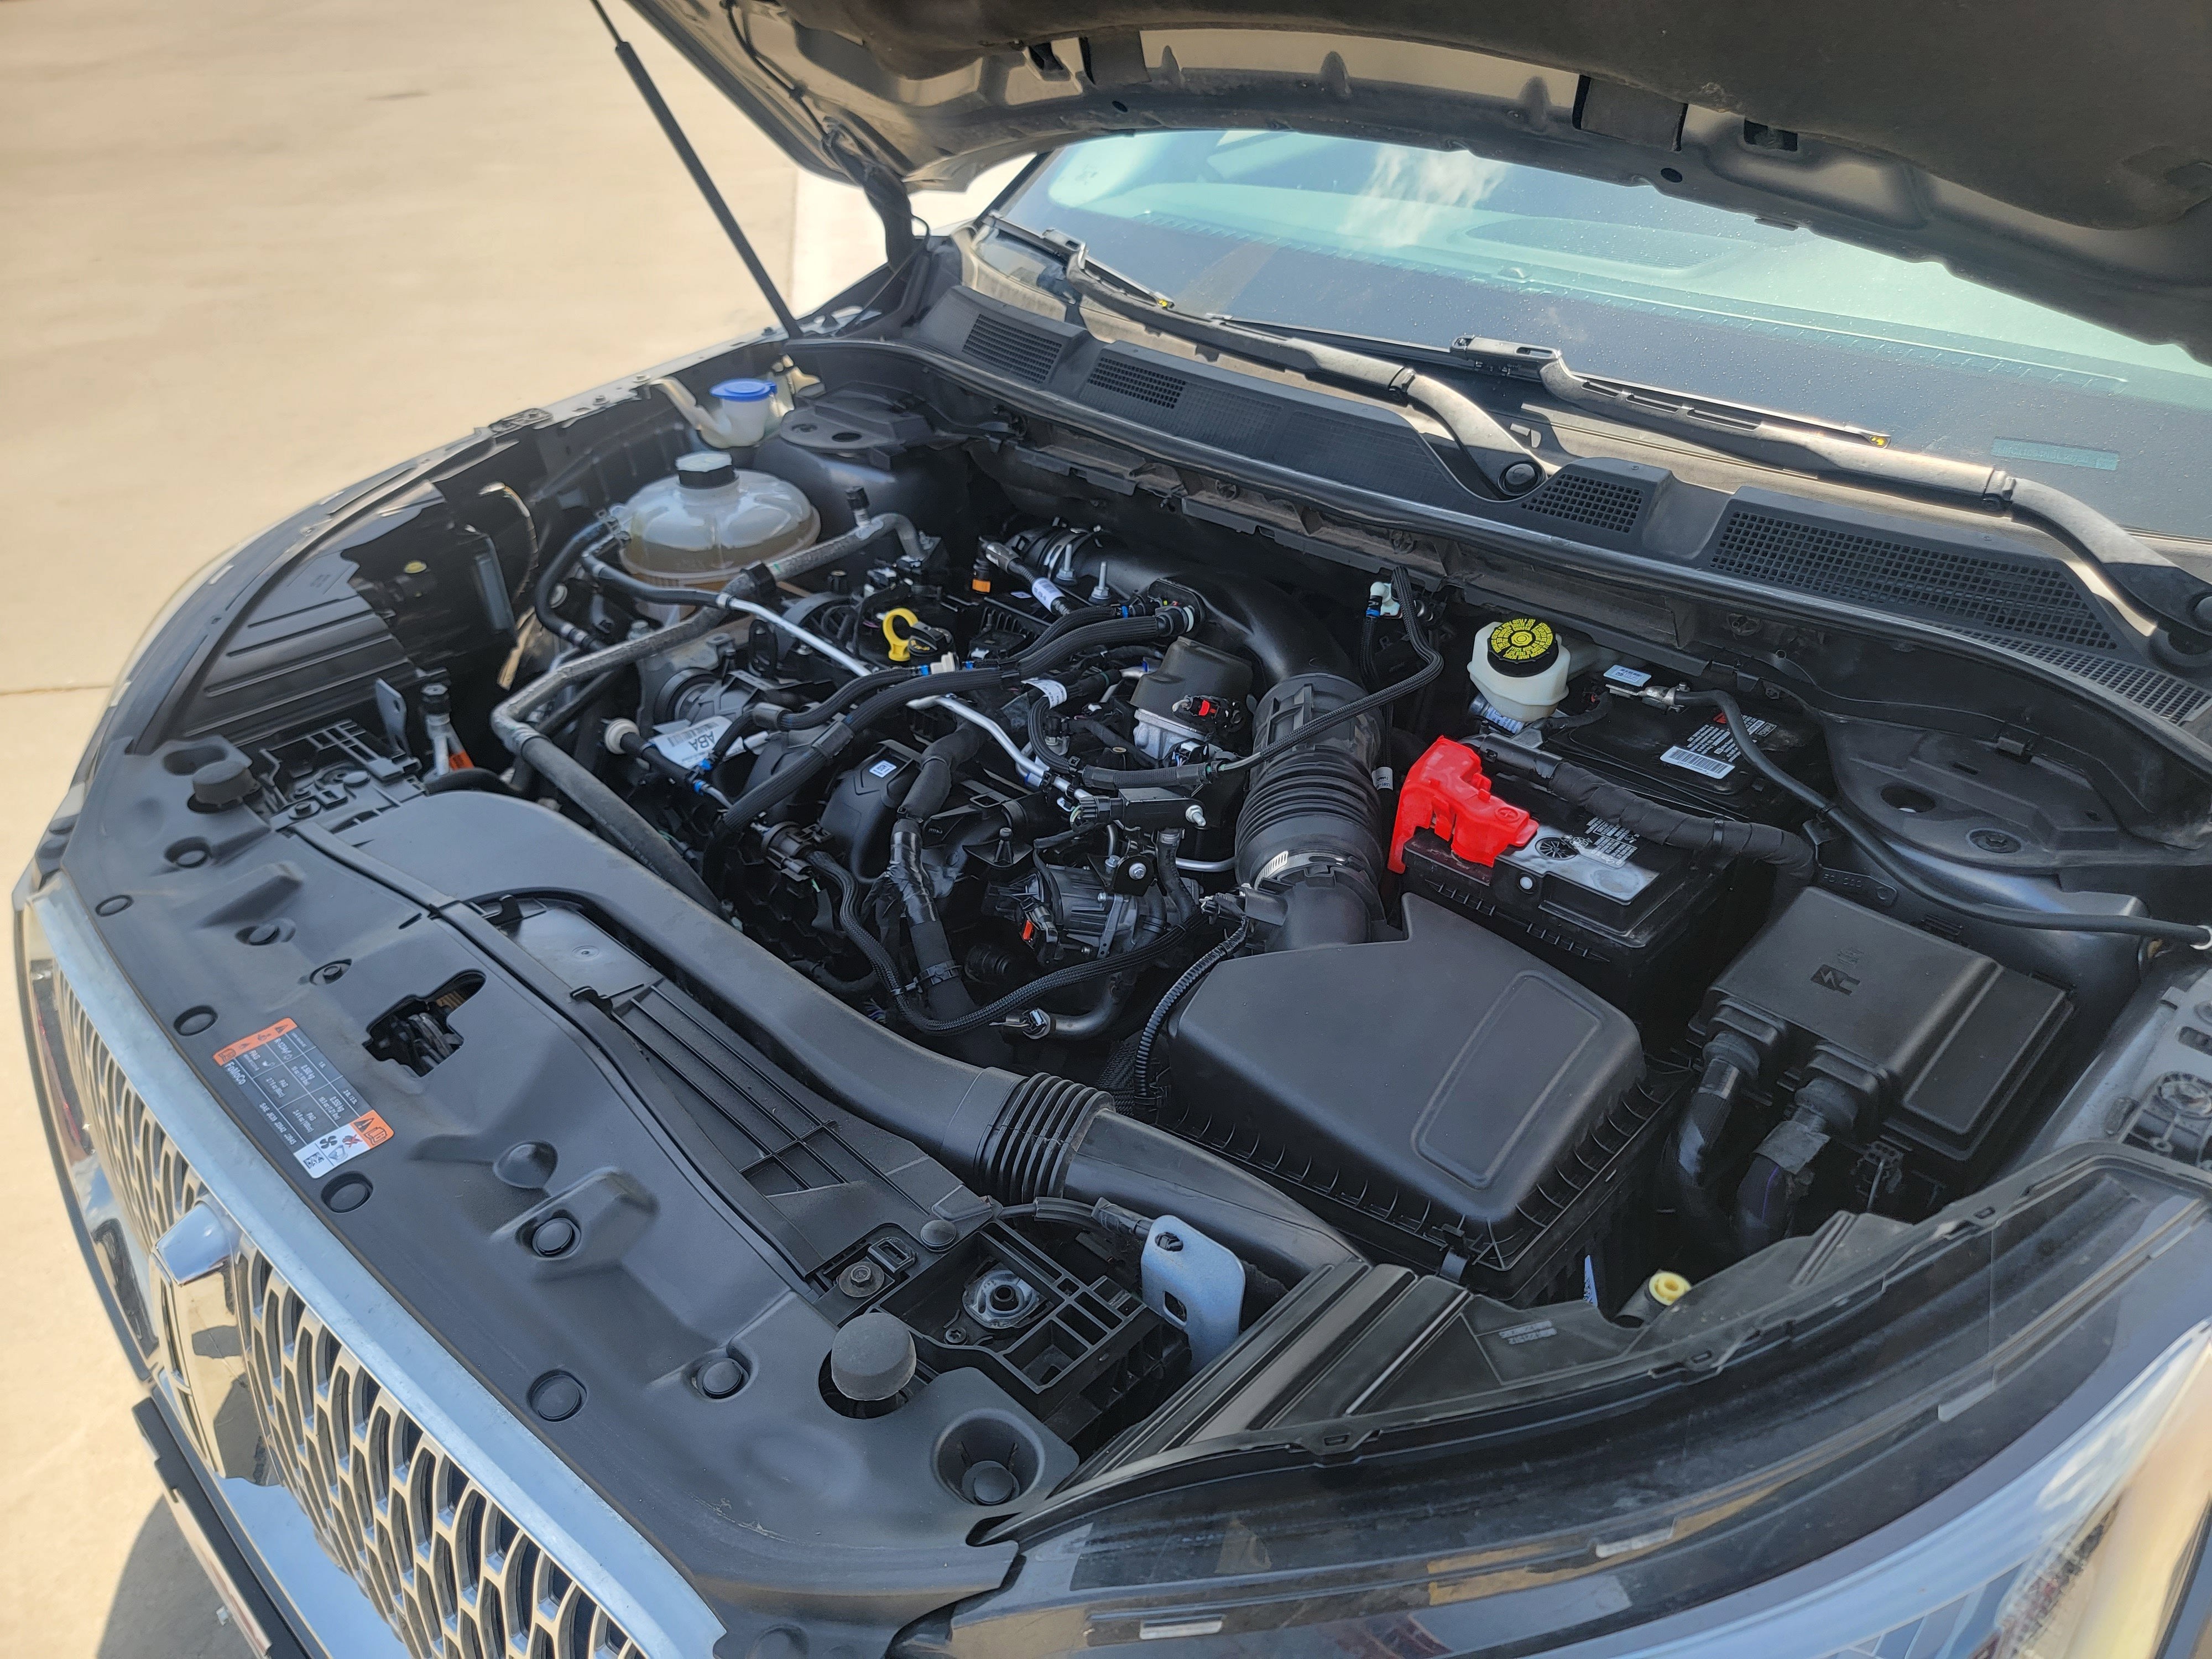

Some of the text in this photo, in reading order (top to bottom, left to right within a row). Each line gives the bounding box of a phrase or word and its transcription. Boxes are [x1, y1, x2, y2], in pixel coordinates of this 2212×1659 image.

[689, 731, 714, 752] ABA
[248, 1049, 261, 1060] PAG
[224, 1061, 249, 1085] FoMoCo
[278, 1078, 289, 1088] PAG
[258, 1102, 270, 1113] SAE
[305, 1112, 317, 1121] PAG
